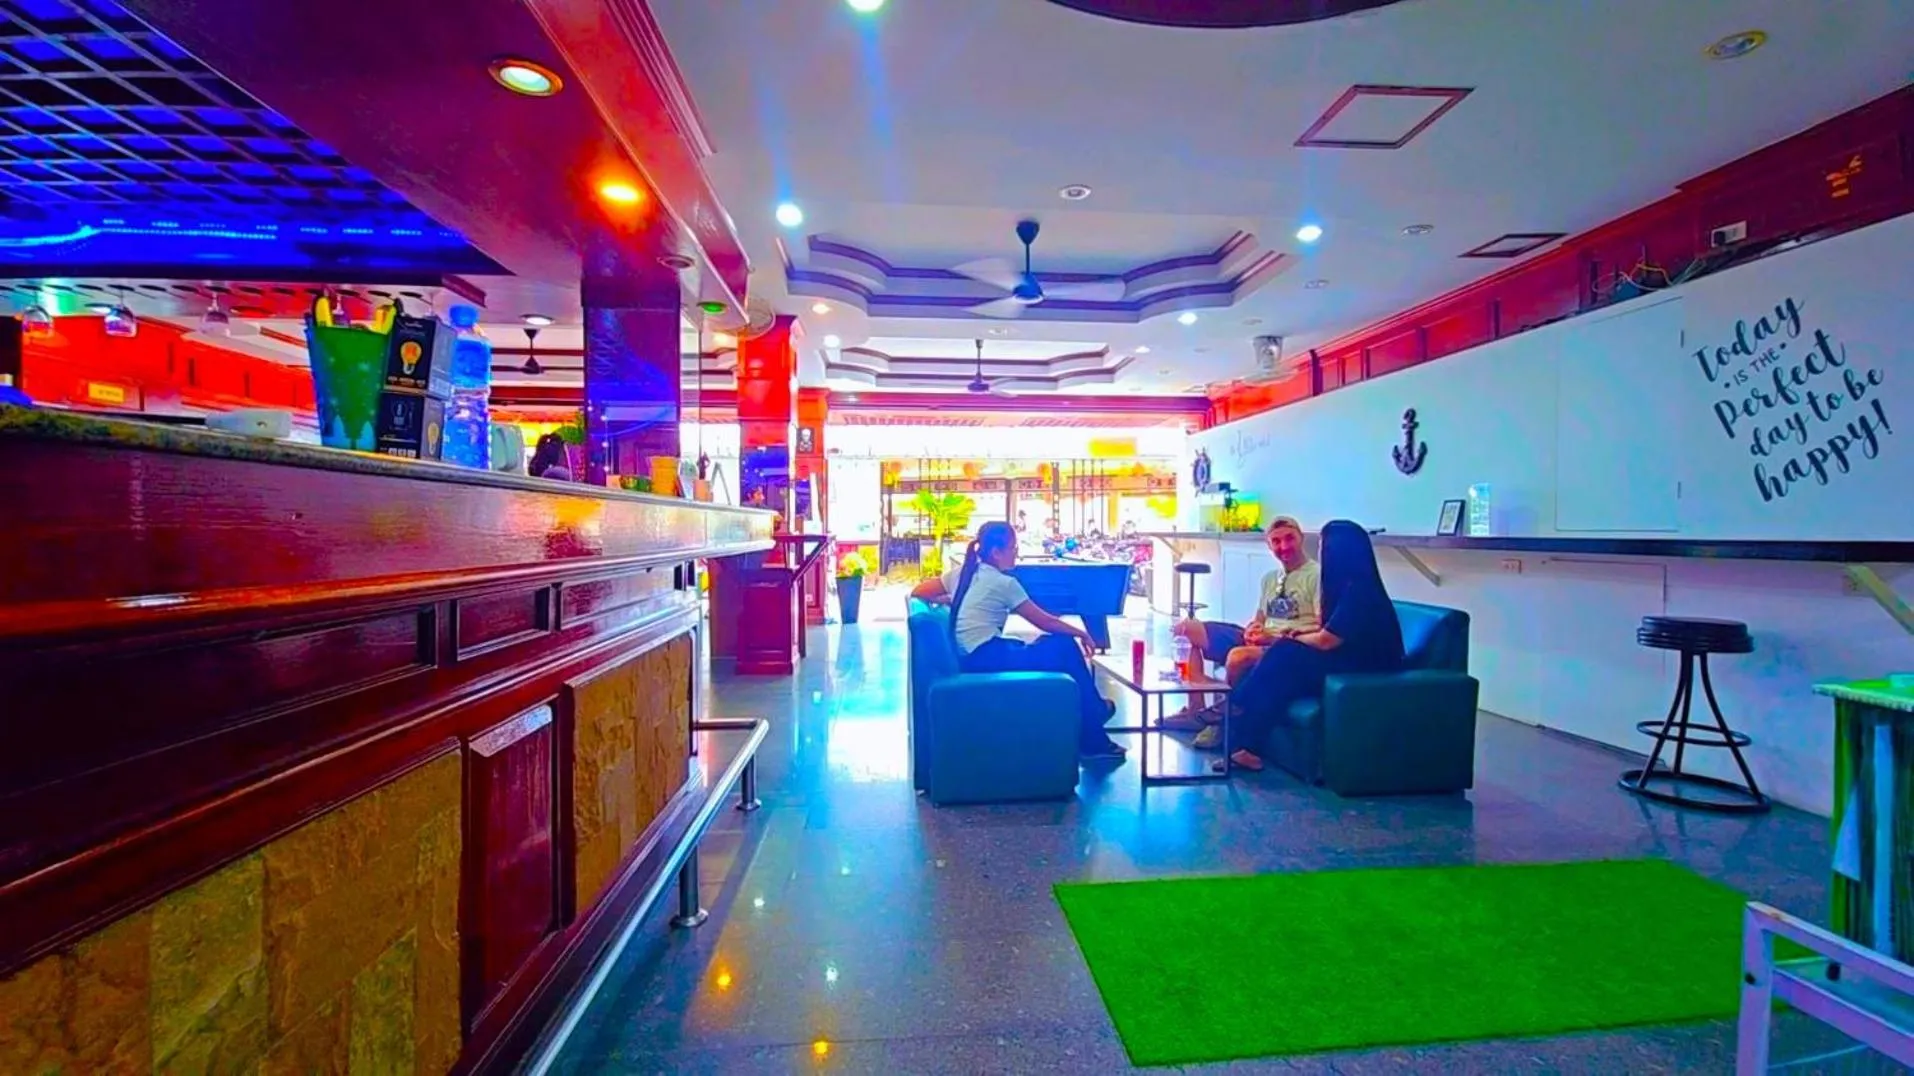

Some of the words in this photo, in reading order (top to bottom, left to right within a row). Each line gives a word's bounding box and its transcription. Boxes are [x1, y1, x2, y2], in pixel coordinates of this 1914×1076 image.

[1692, 297, 1805, 383] Today
[1733, 369, 1748, 386] IS
[1750, 349, 1780, 373] THE
[1750, 412, 1810, 456] day
[1806, 390, 1844, 422] to
[1843, 368, 1884, 400] be
[1754, 399, 1893, 502] happy!
